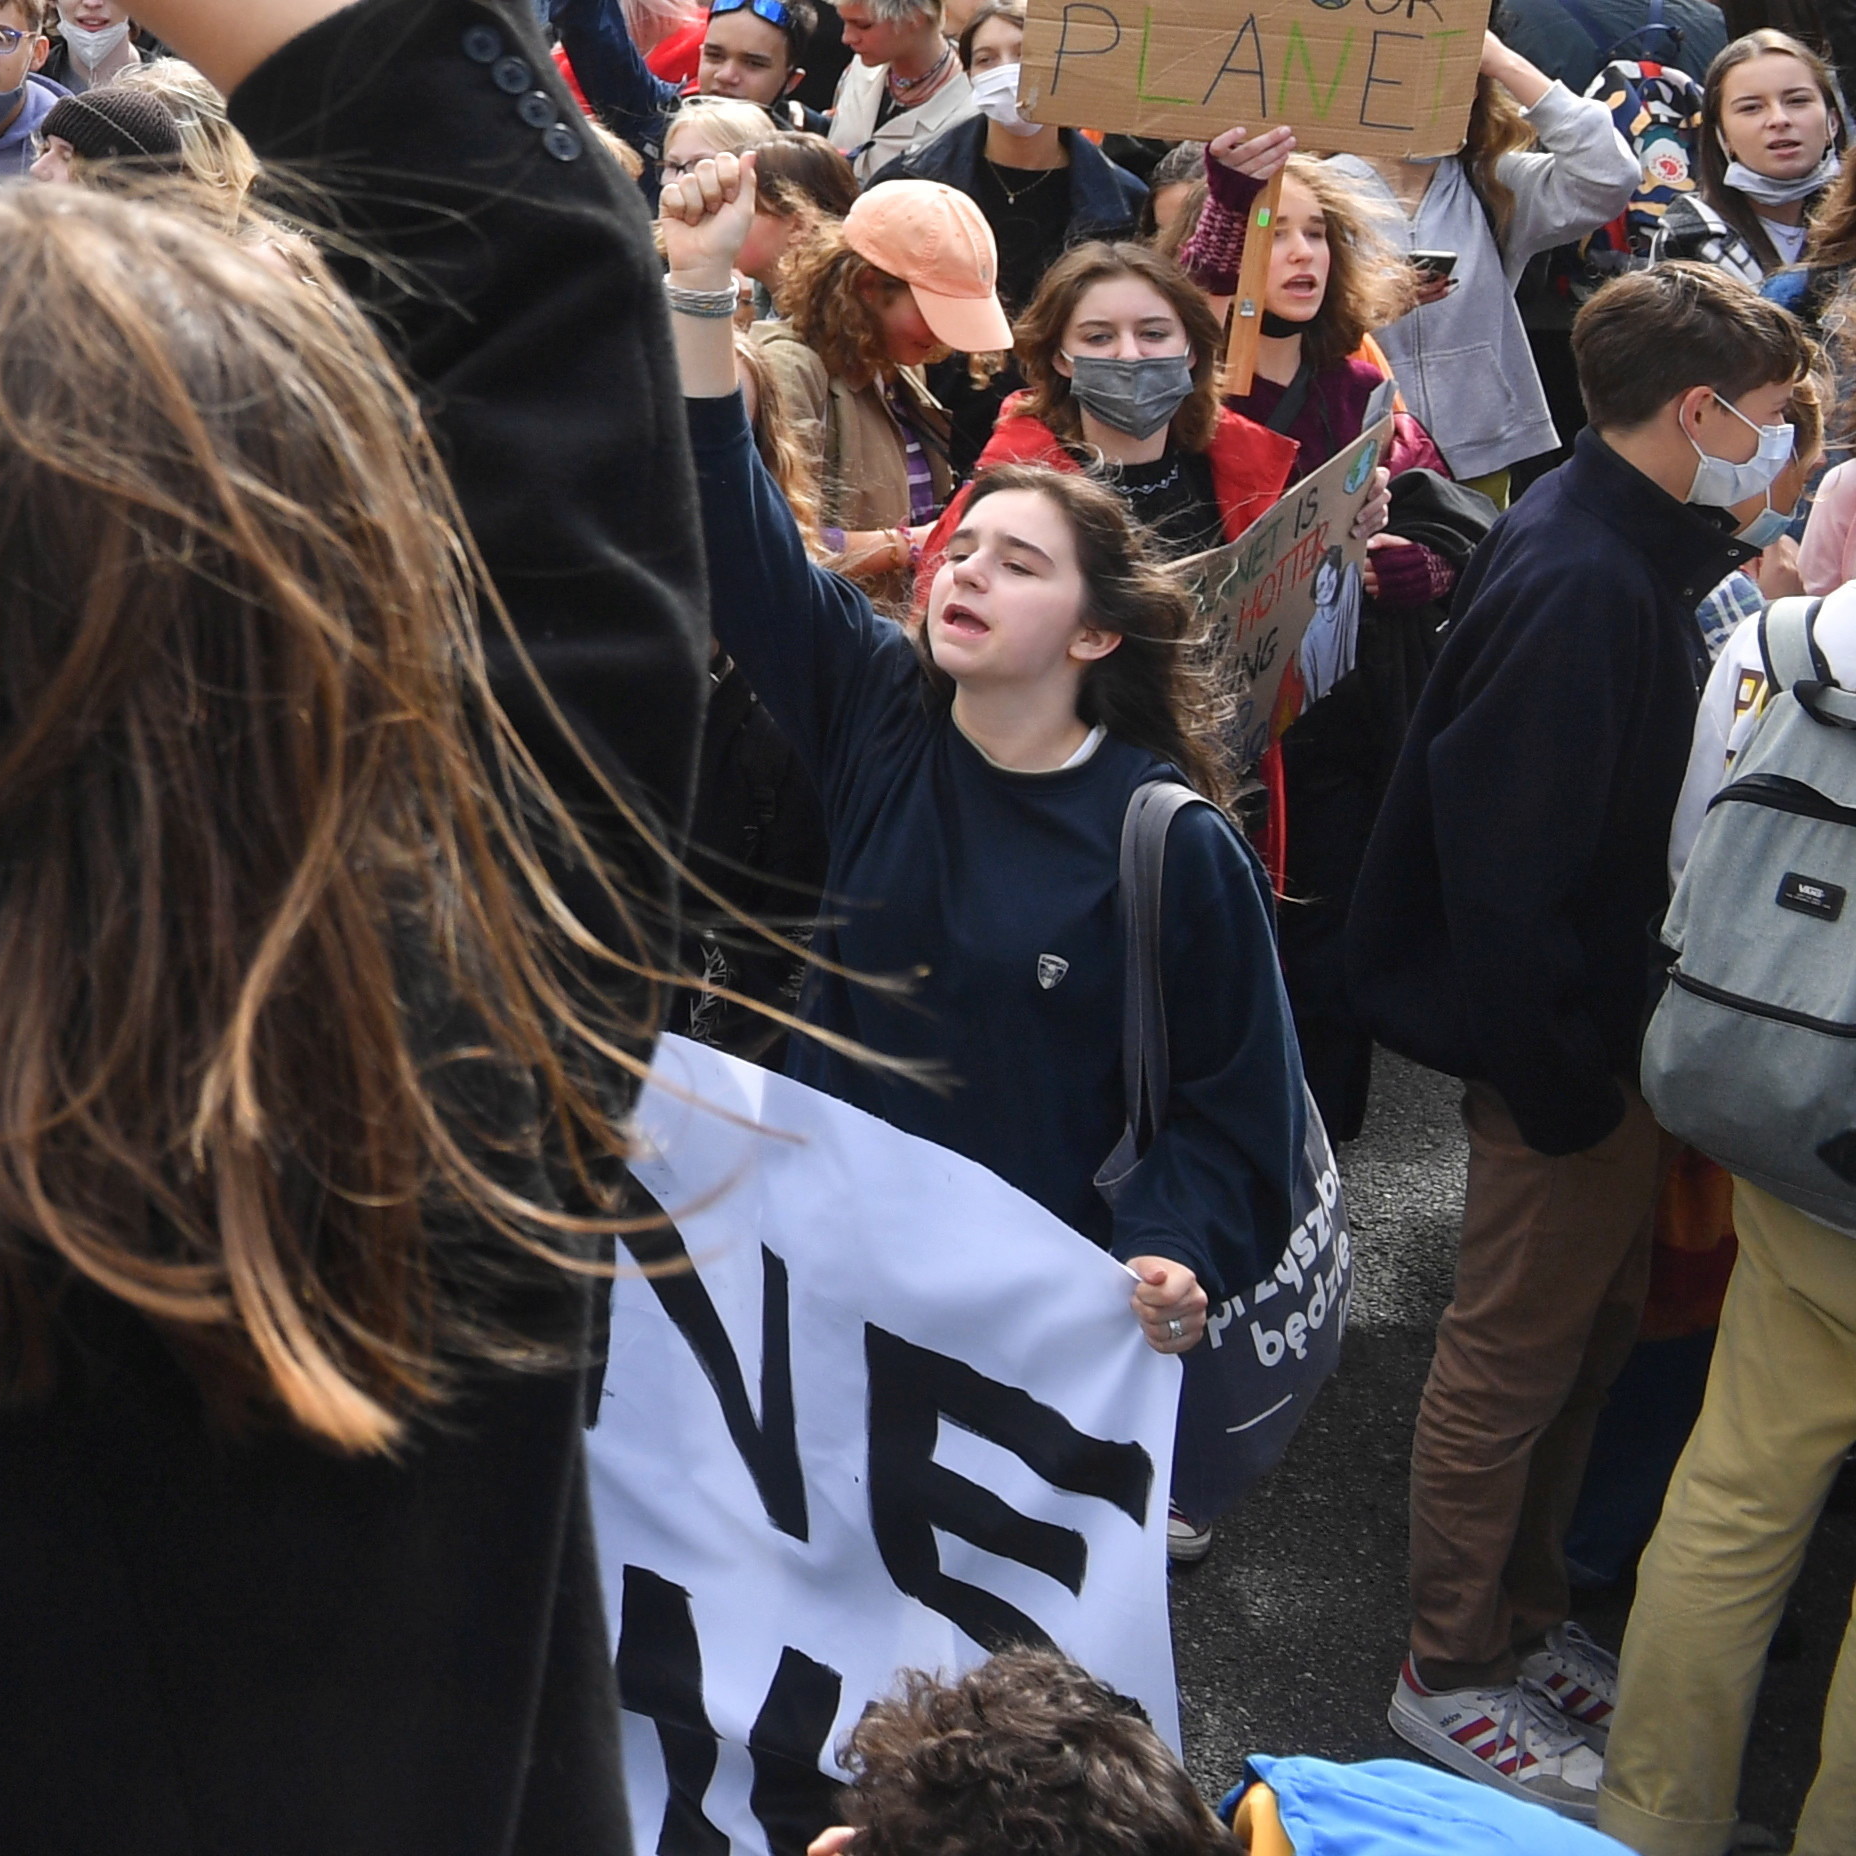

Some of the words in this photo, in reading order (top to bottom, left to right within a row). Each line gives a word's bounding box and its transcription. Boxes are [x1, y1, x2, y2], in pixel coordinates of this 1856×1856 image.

[1051, 2, 1467, 131] PLANET
[1294, 487, 1318, 538] IS
[1238, 521, 1330, 642] HOTTER
[1250, 1231, 1350, 1367] będzie
